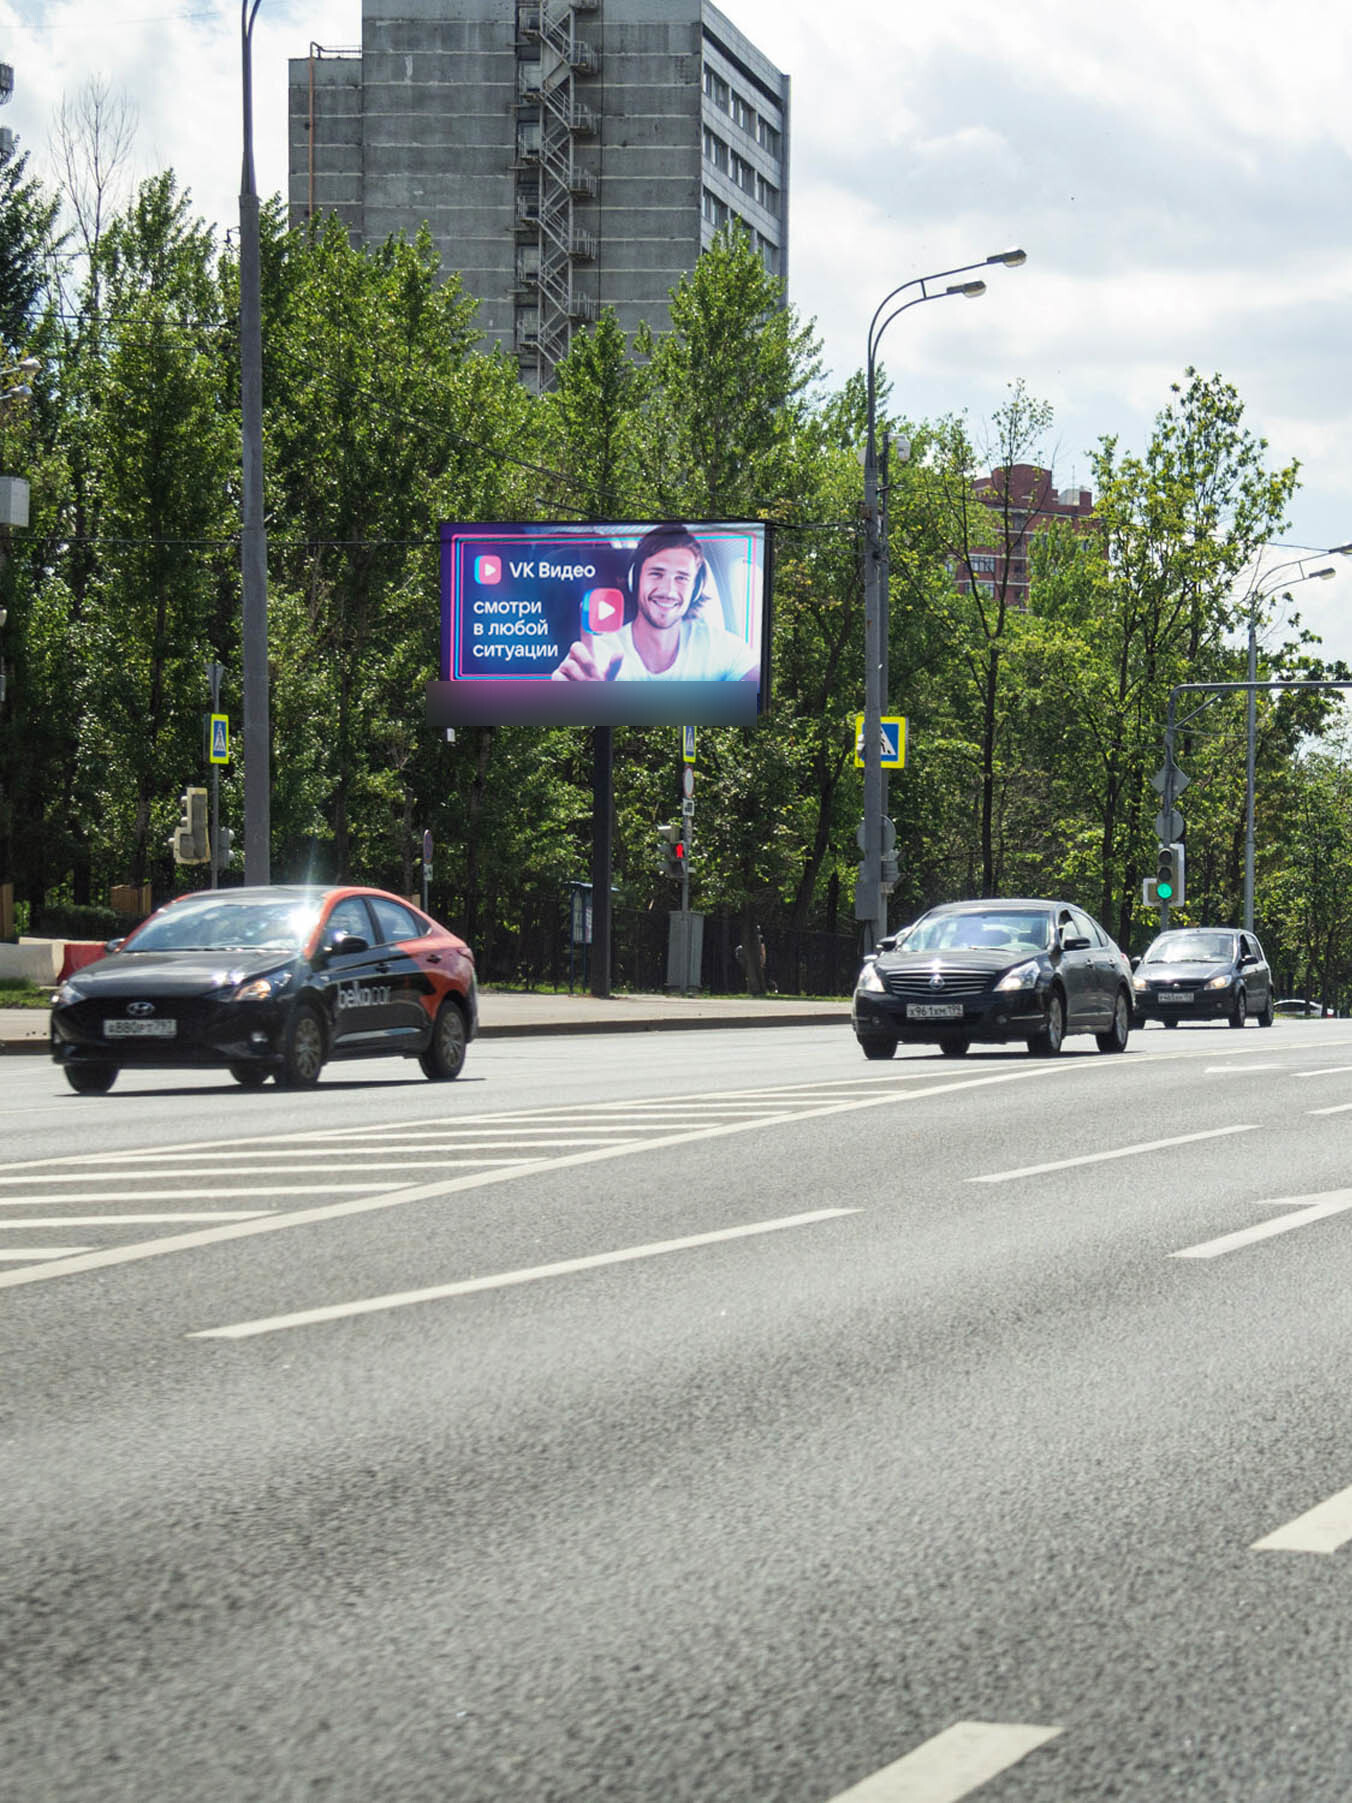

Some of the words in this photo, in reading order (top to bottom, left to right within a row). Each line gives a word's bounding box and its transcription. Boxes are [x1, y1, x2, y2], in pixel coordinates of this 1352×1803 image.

[509, 562, 535, 578] VK
[538, 562, 596, 581] Видео
[473, 601, 542, 617] смотри
[473, 623, 484, 636] в
[488, 619, 549, 636] любой
[473, 644, 559, 662] ситуации
